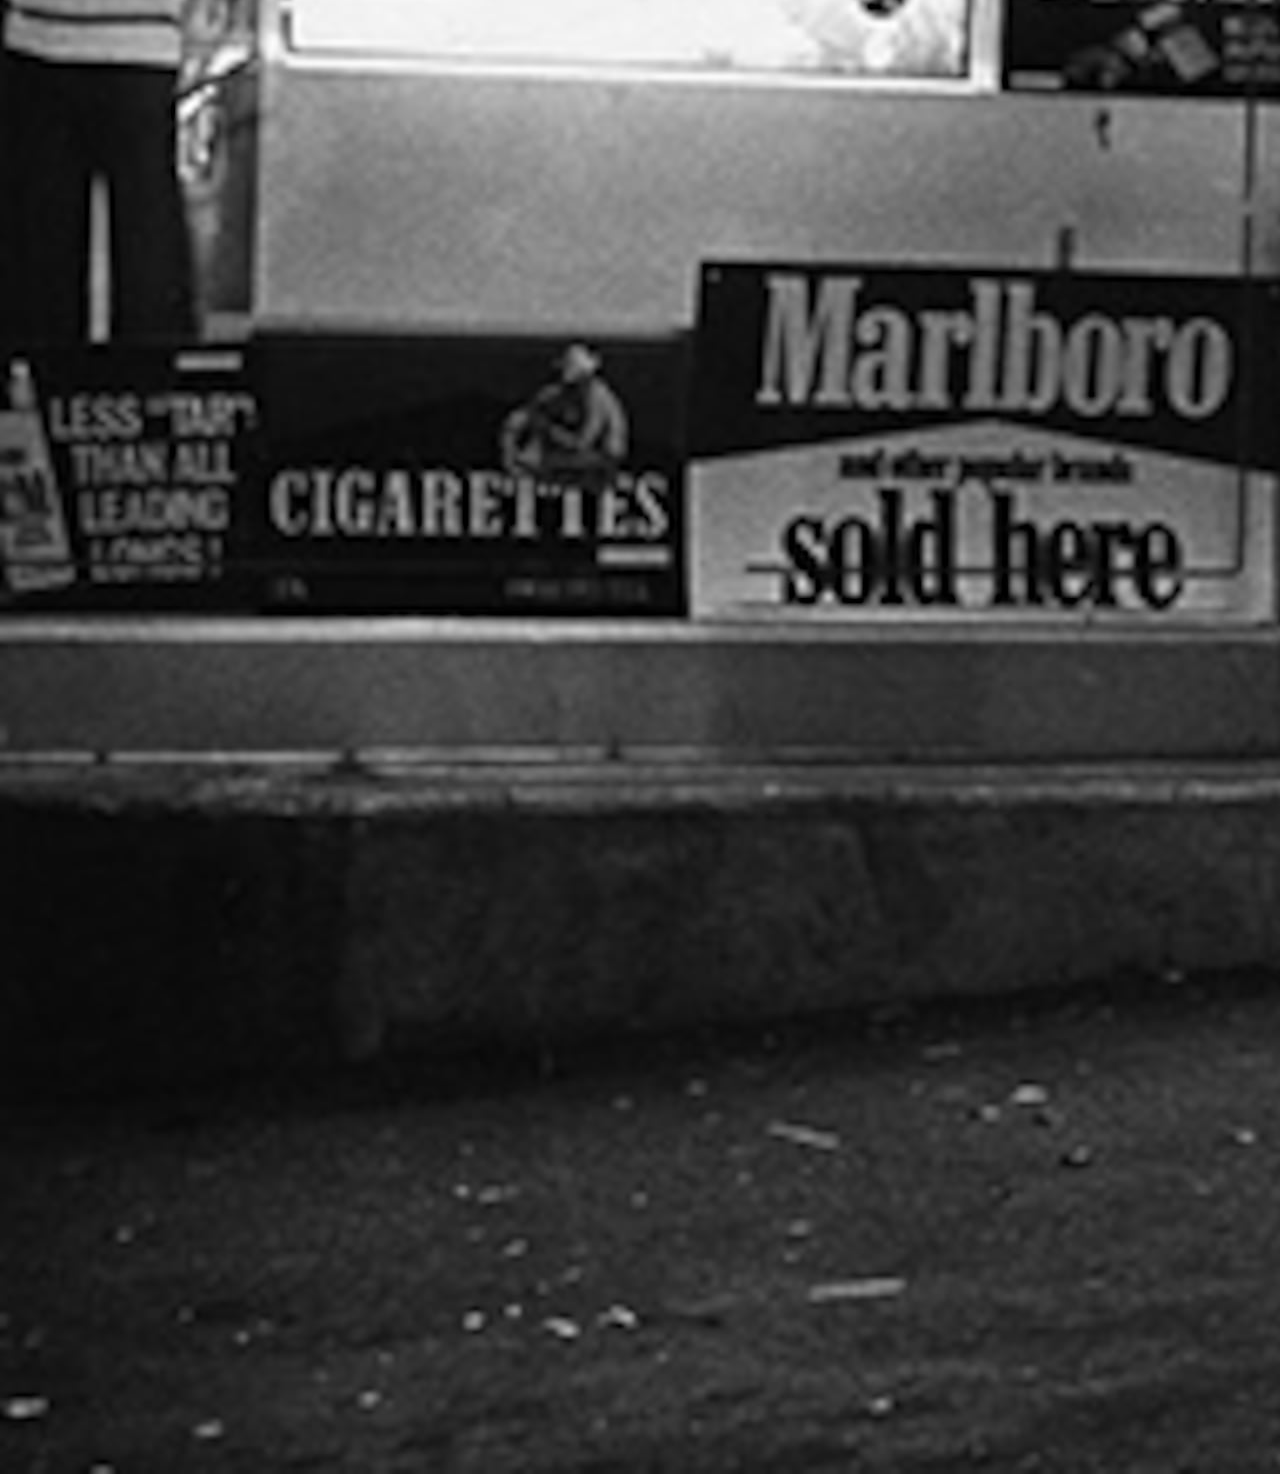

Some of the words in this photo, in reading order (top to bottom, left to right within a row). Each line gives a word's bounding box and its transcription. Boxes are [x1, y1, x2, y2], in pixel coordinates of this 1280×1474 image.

[756, 273, 1232, 418] Marlboro
[51, 393, 143, 443] LESS
[70, 443, 167, 483] THAN
[172, 443, 237, 483] ALL
[840, 447, 885, 479] and
[892, 447, 951, 480] other
[77, 488, 229, 534] LEADING
[268, 466, 670, 540] CIGARETTES
[783, 490, 955, 607] sold
[992, 490, 1183, 611] here
